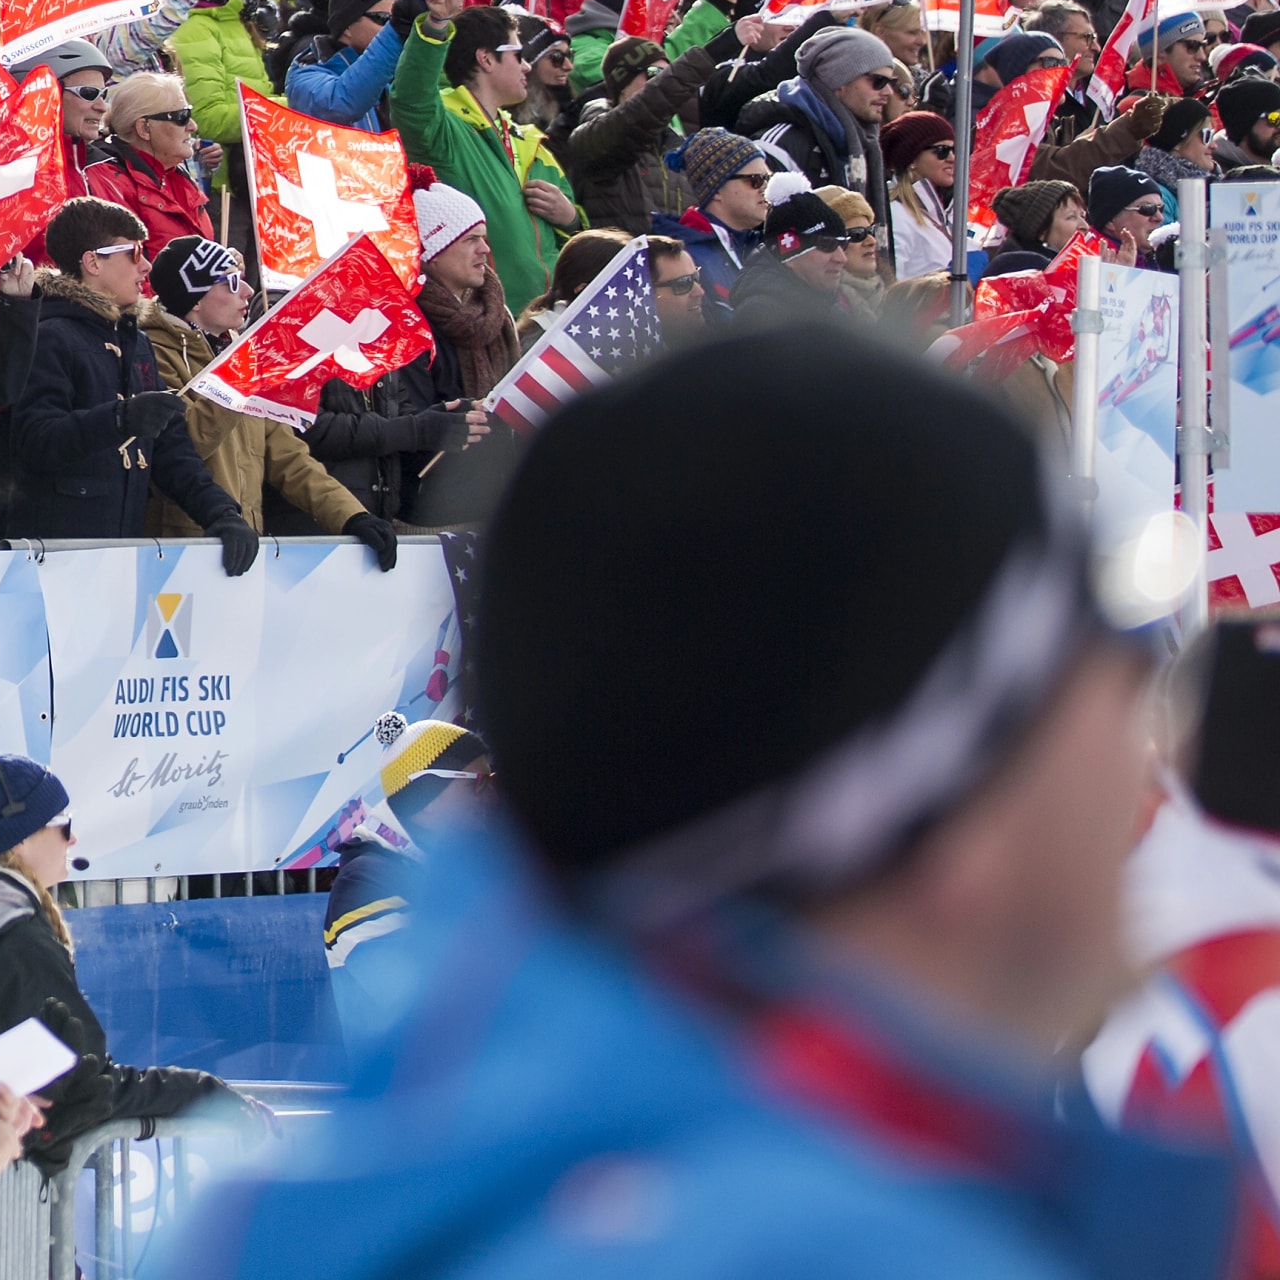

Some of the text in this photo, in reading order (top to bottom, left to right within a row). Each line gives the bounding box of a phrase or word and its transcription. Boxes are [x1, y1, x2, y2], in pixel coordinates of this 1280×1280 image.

[10, 33, 55, 60] swisscom
[115, 675, 231, 705] AUDI FIS SKI
[113, 710, 226, 738] WORLD CUP
[106, 749, 230, 798] St. Moritz
